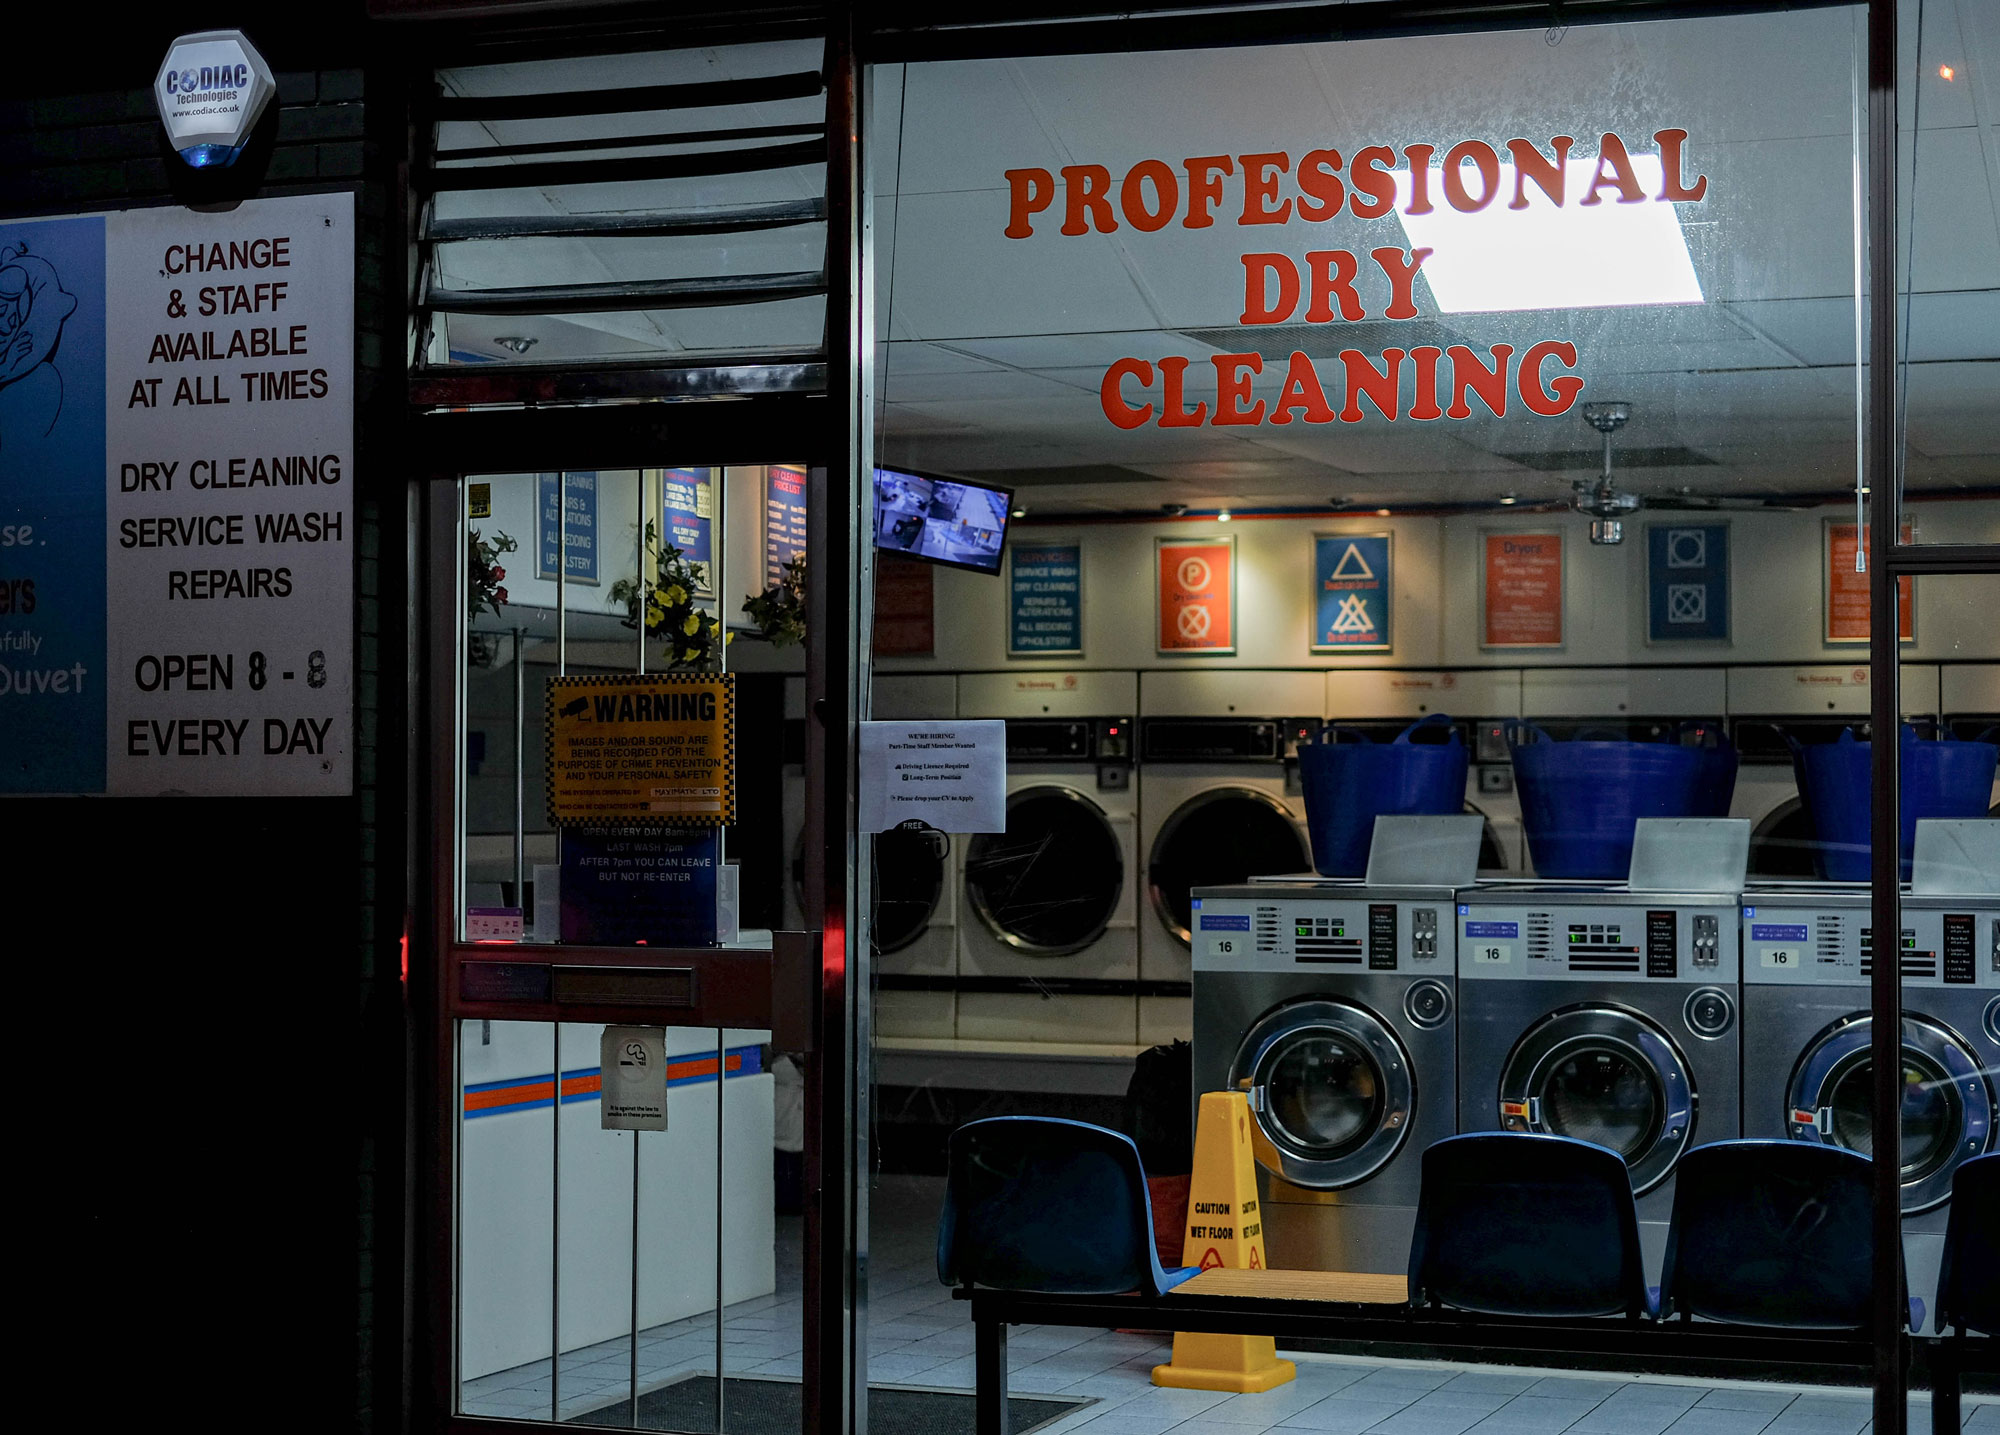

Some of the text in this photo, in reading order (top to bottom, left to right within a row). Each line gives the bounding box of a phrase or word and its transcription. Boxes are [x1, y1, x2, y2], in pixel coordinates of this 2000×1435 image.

[176, 90, 238, 105] Technologies
[172, 104, 240, 118] www.codiac.co.uk
[1003, 128, 1708, 240] PROFESSIONAL
[164, 237, 291, 276] CHANGE
[1239, 246, 1435, 326] DRY
[166, 282, 289, 319] & STAFF
[147, 325, 308, 364] AVAILABLE
[128, 368, 329, 408] AT ALL TIMES
[1100, 340, 1585, 430] CLEANING
[120, 454, 341, 492] DRY CLEANING
[119, 511, 343, 549] SERVICE WASH
[566, 533, 592, 548] EDDING
[168, 567, 293, 600] REPAIRS
[134, 649, 328, 692] OPEN 8 - 8
[594, 692, 716, 723] WARNING
[127, 717, 334, 757] EVERY DAY
[568, 736, 708, 747] IMAGES AND/OR SOUND ARE
[571, 746, 705, 758] BEING RECORDED FOR THE
[558, 758, 721, 770] PURPOSE OF CRIME PREVENTION
[566, 770, 712, 780] AND YOUR PERSONAL SAFETY
[582, 828, 609, 836] OPEN
[611, 828, 642, 836] EVERY
[644, 828, 662, 836] DAY
[902, 822, 923, 830] FREE
[606, 843, 683, 854] LAST WASH 7pm
[580, 858, 711, 868] AFTER 7pm YOU CAN LEAVE
[599, 872, 691, 882] BUT NOT RE-ENTER
[1460, 906, 1466, 914] 2
[1746, 908, 1753, 916] 3
[1218, 942, 1232, 952] 16
[1485, 948, 1500, 960] 16
[1772, 952, 1787, 964] 16
[496, 966, 512, 976] 43
[1194, 1202, 1230, 1215] CAUTION
[1190, 1226, 1234, 1240] WET FLOOR
